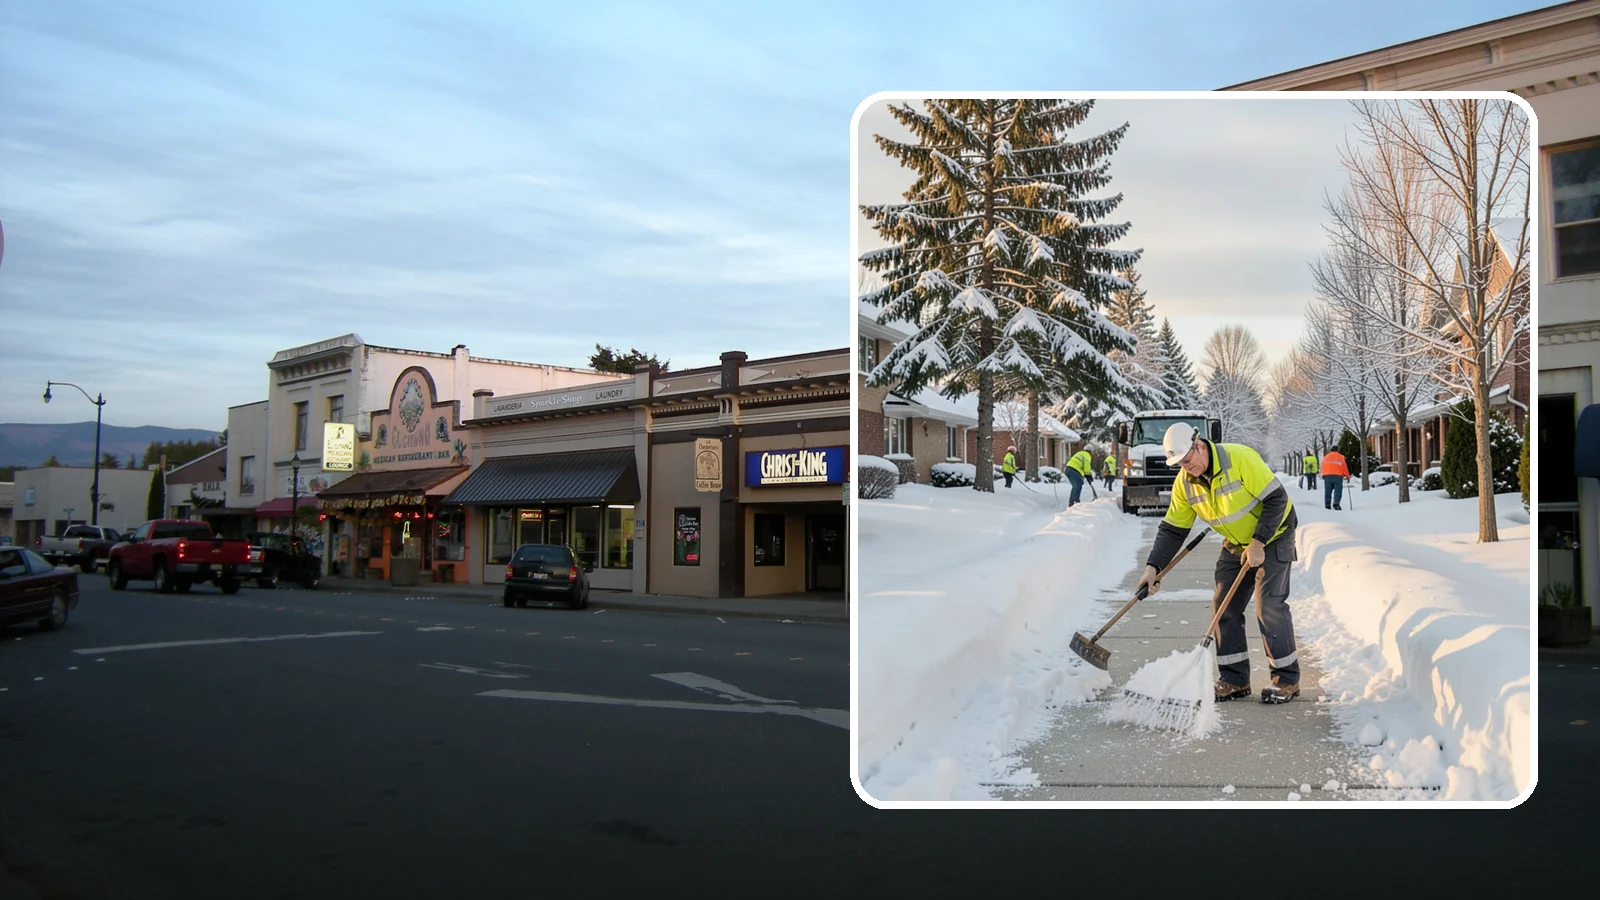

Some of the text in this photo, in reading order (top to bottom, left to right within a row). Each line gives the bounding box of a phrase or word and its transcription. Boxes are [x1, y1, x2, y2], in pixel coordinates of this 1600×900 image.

[493, 388, 624, 413] LAVANDERIA Sparkle Shop LAUNDRY
[373, 454, 396, 464] MEXICAN
[398, 451, 434, 462] RESTAURANT
[437, 450, 450, 459] BAR
[799, 450, 827, 476] KING
[696, 481, 709, 489] Coffee
